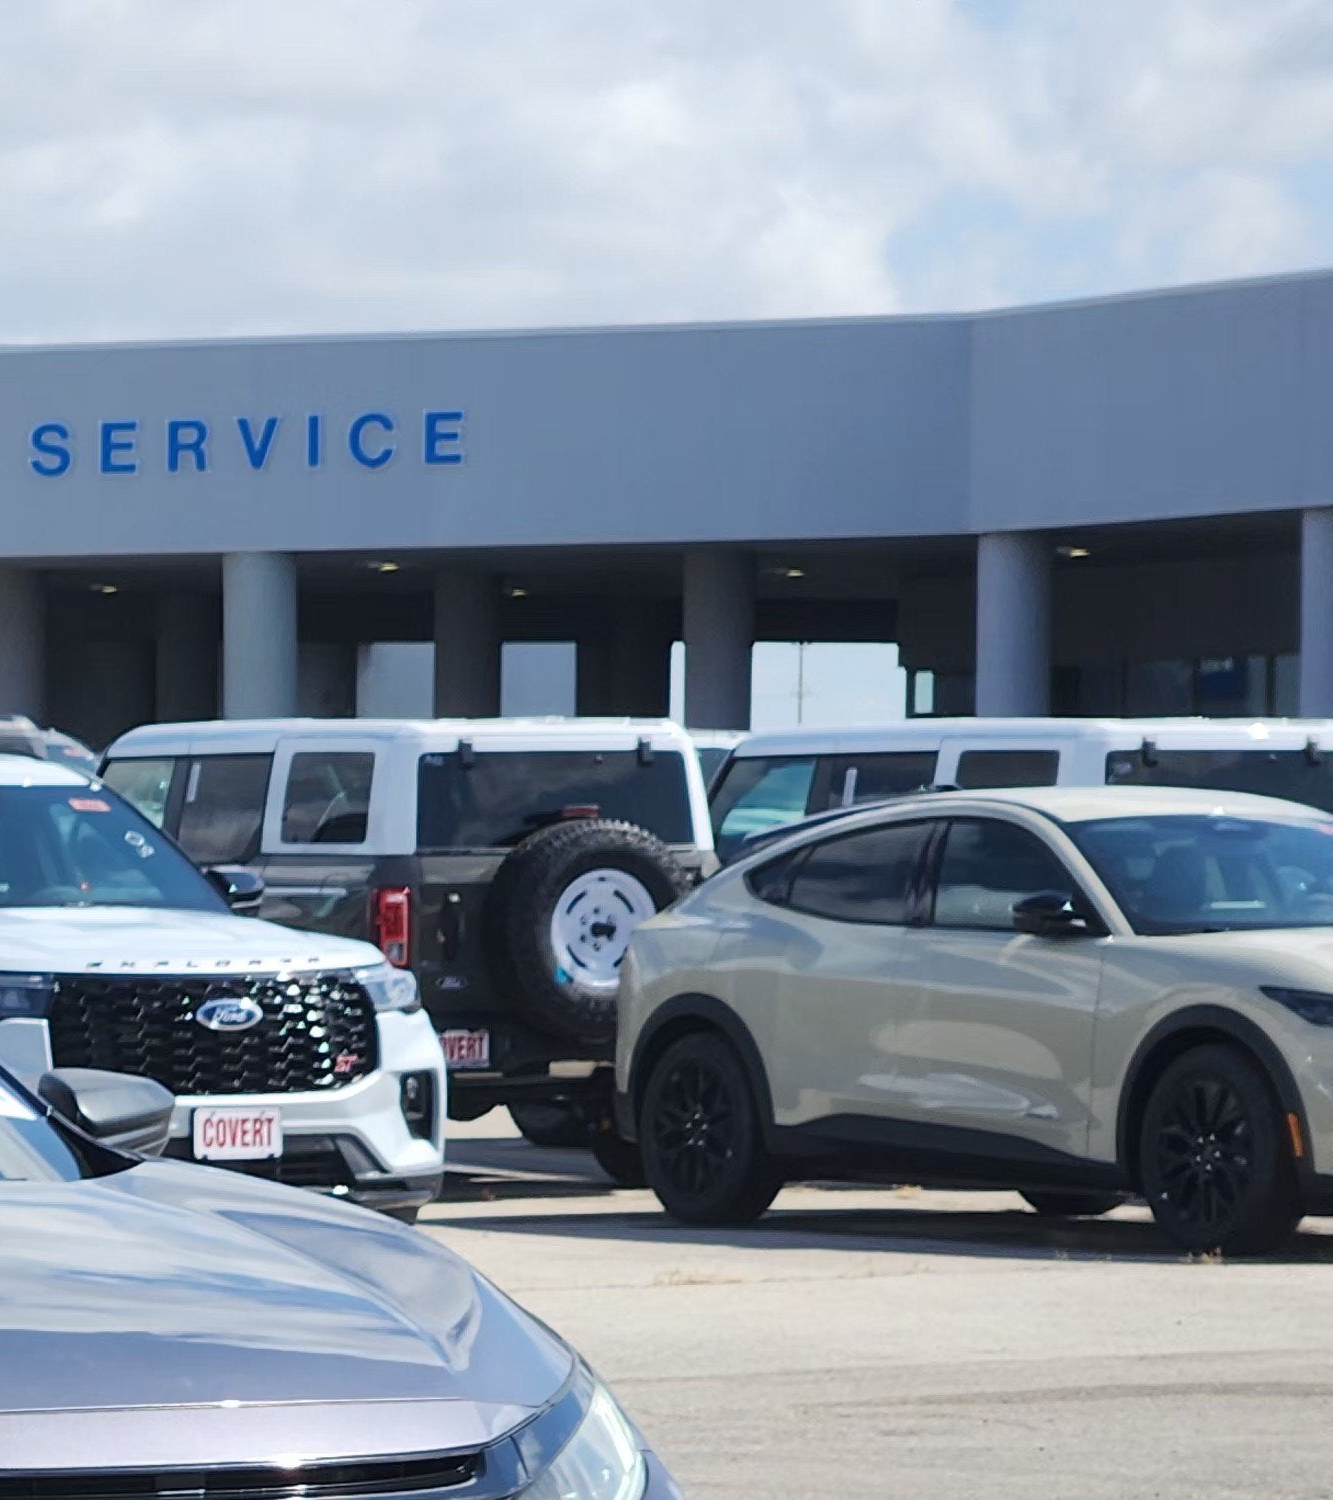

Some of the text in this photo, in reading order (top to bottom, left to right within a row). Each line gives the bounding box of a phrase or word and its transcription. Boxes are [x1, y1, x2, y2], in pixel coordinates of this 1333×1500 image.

[31, 410, 465, 477] SERVICE
[438, 1035, 484, 1060] VERT
[203, 1117, 275, 1148] COVERT
